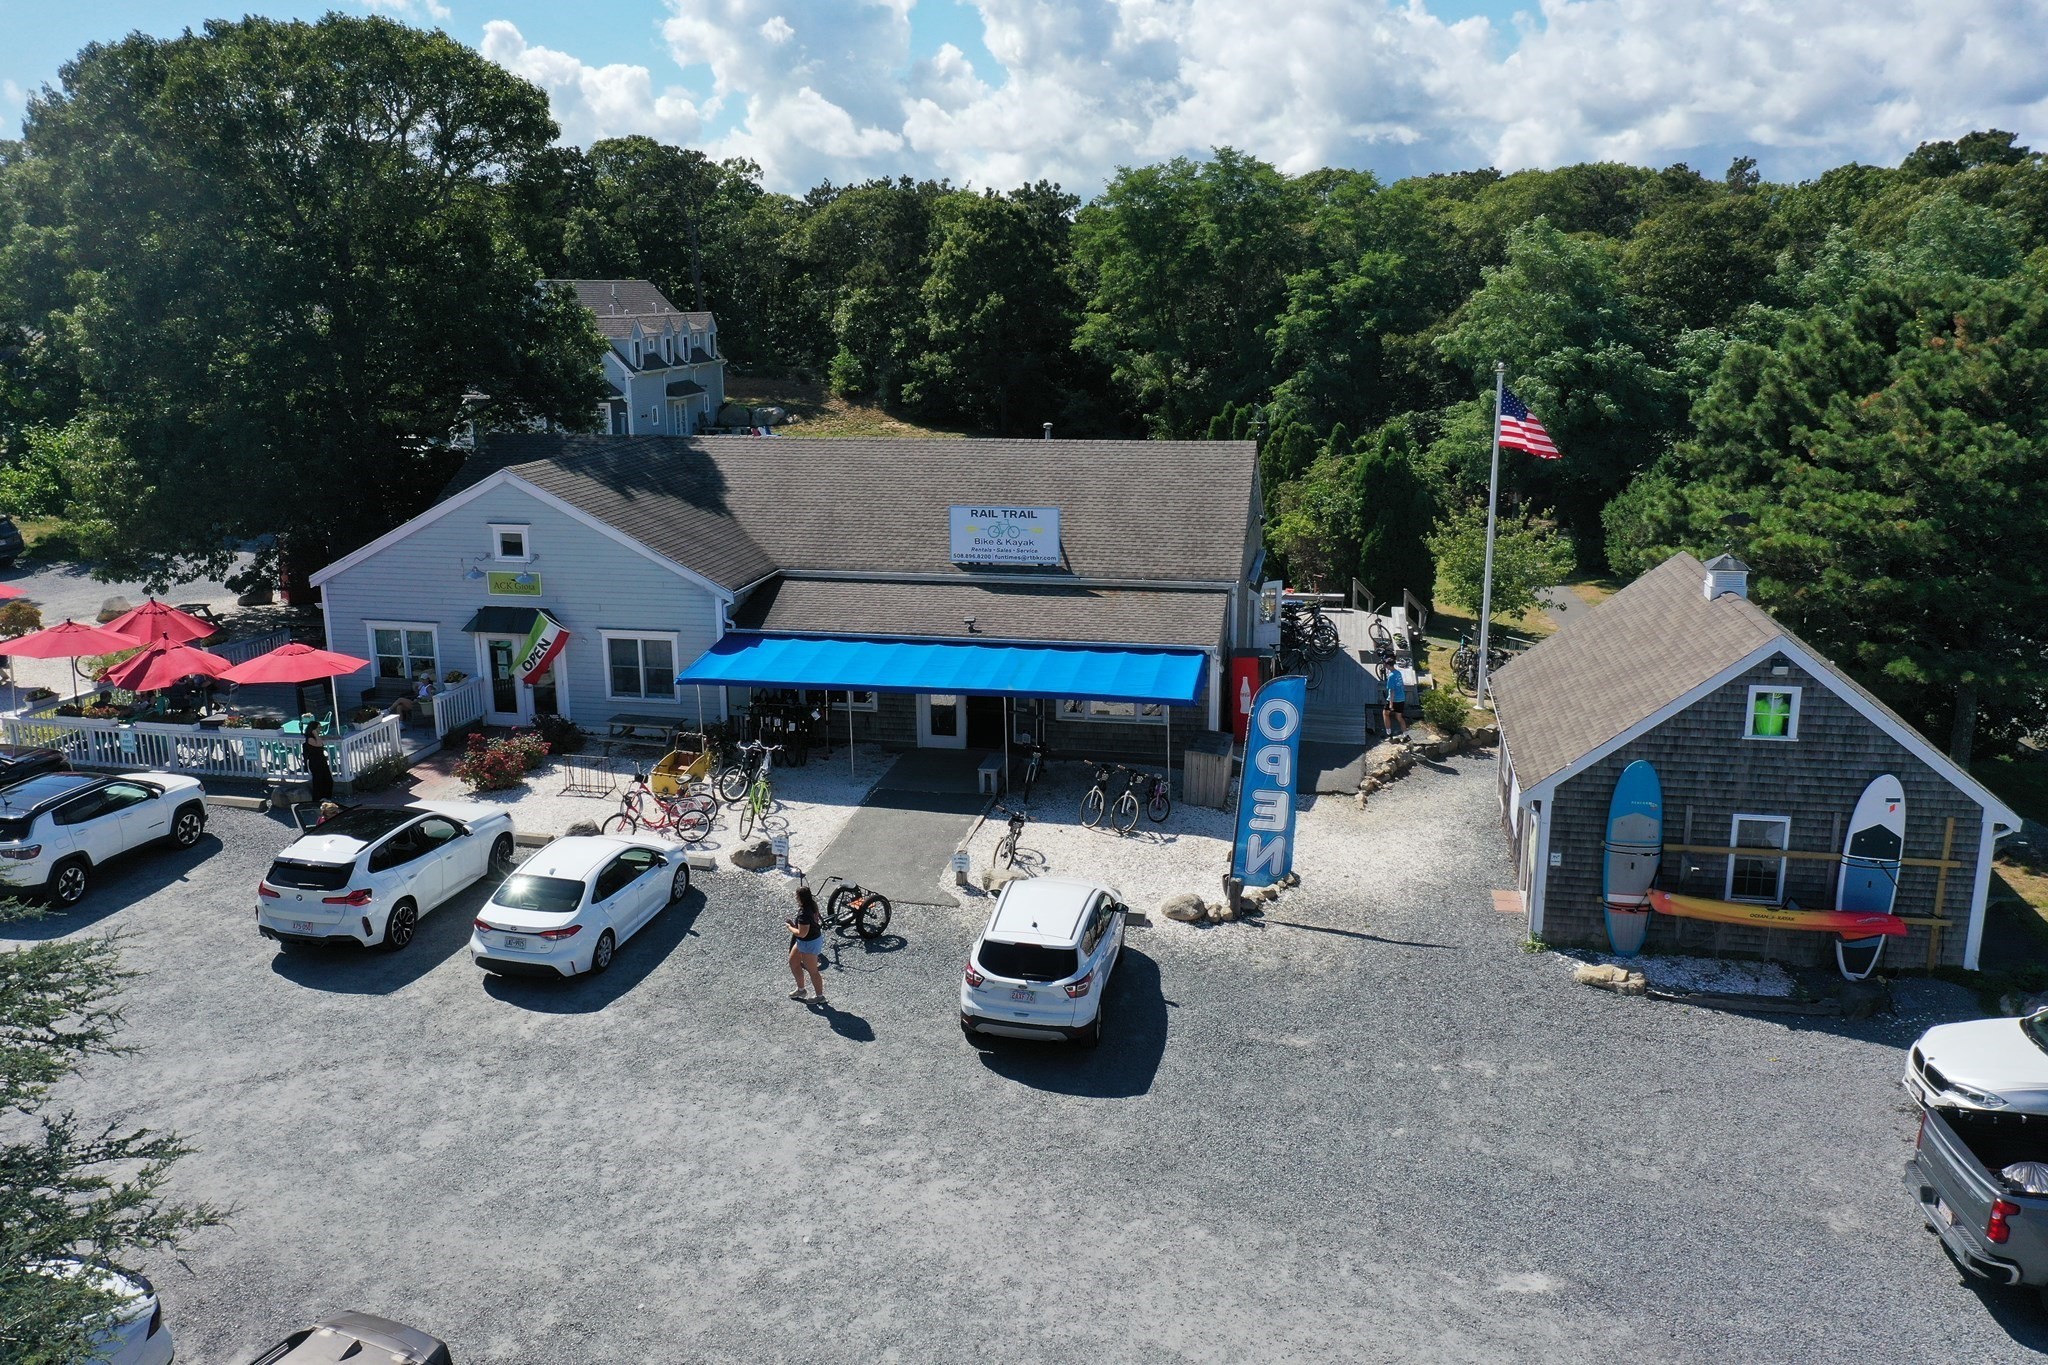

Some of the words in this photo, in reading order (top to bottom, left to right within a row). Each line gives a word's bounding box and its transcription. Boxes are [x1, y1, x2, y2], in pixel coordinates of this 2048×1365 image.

[970, 509, 998, 518] RAIL
[1001, 510, 1038, 519] TRAIL
[974, 537, 994, 545] Bike
[1005, 538, 1035, 547] Kayak
[494, 582, 512, 590] ACK
[521, 638, 552, 672] OPEN
